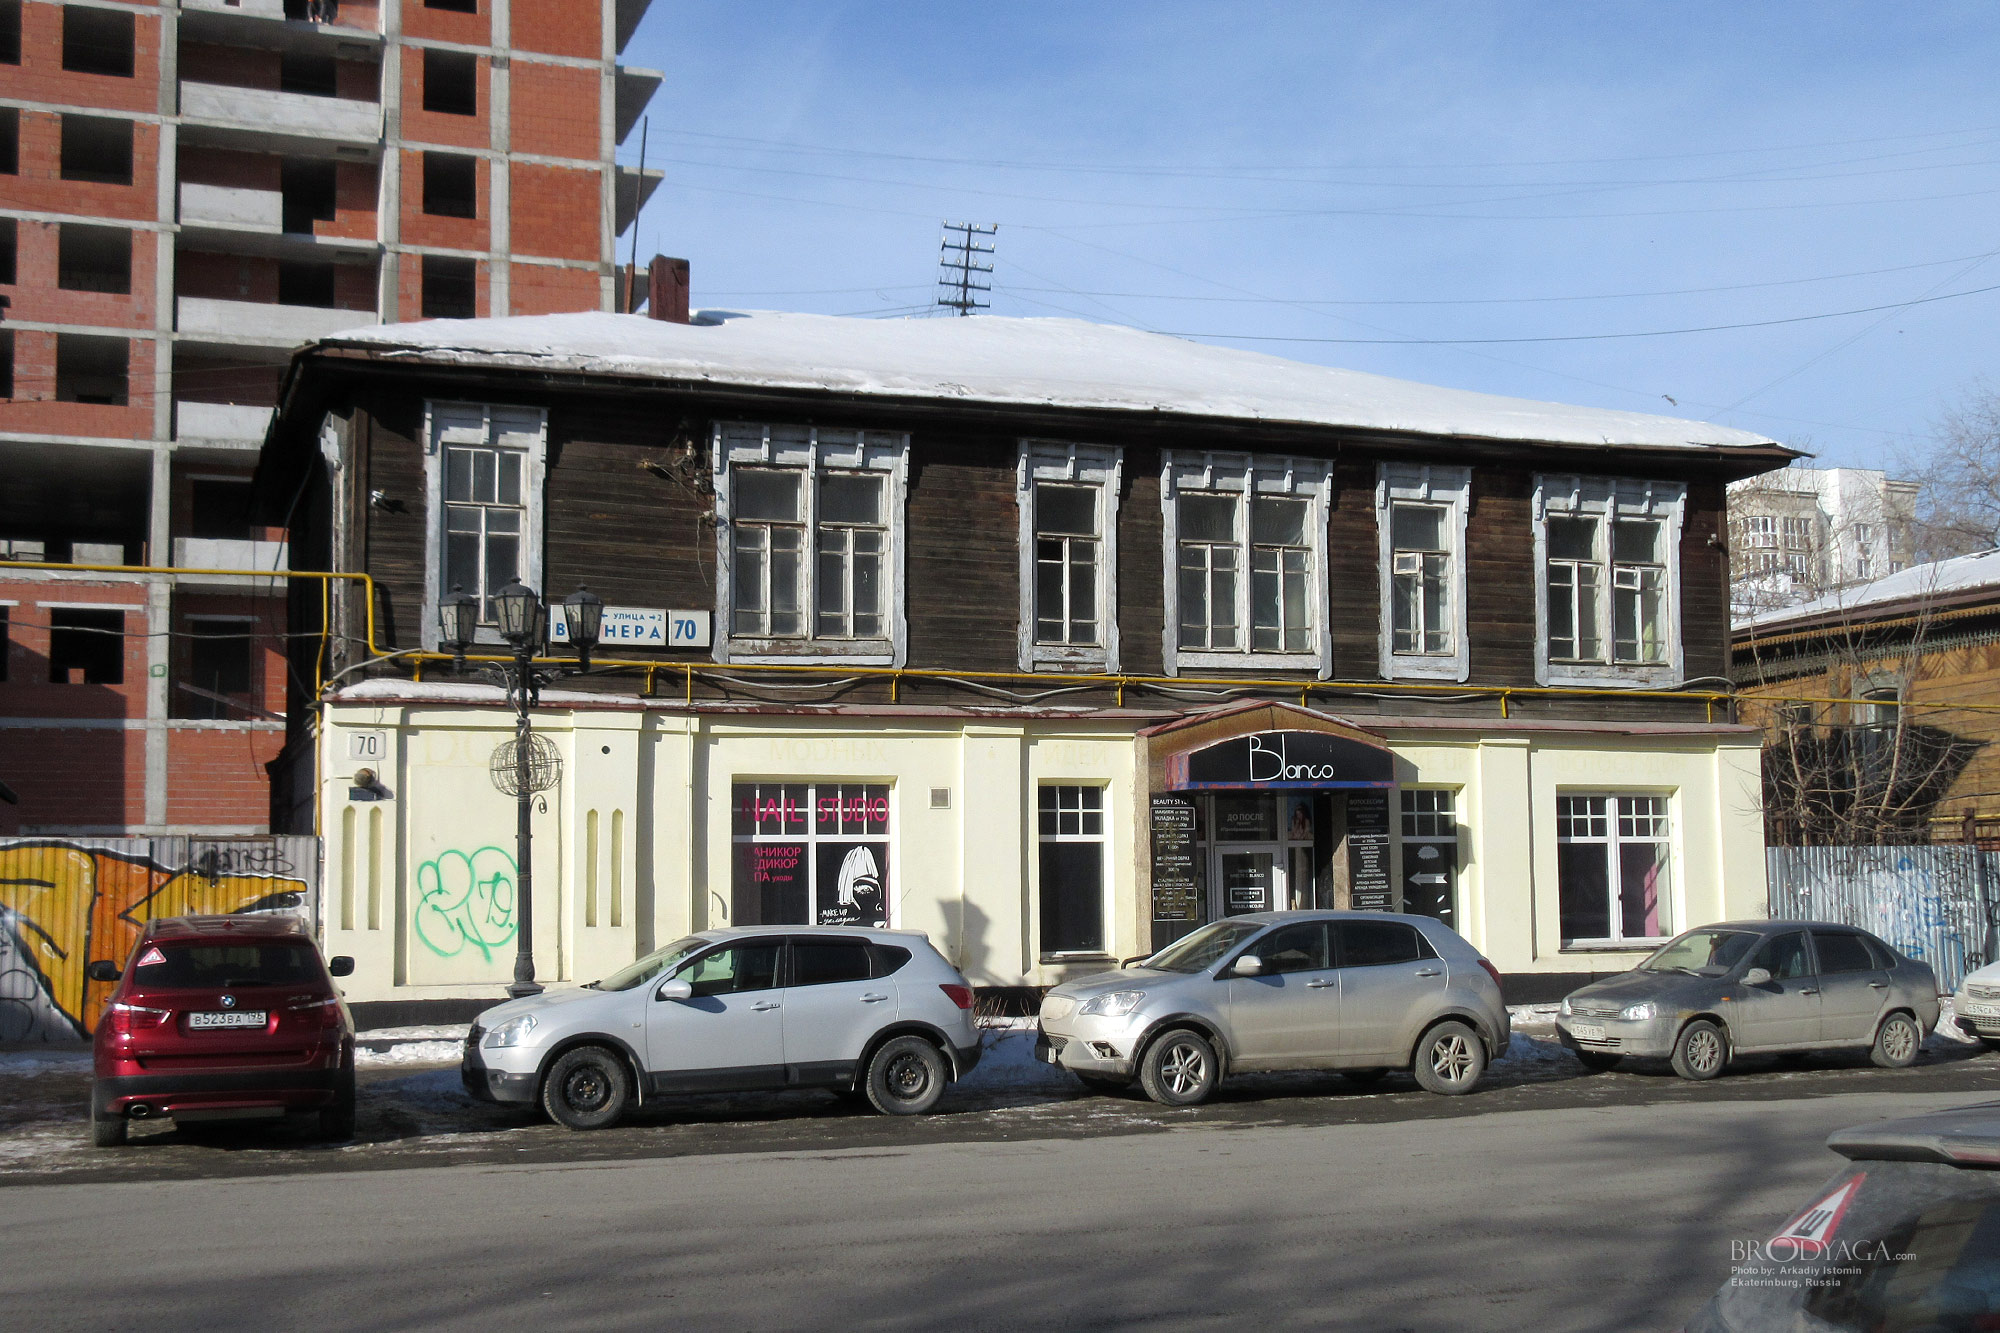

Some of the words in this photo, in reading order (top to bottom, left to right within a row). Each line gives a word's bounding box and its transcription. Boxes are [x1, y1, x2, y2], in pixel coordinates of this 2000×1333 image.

[613, 613, 645, 621] УЛИЦА
[556, 623, 661, 639] ВНЕРА
[674, 620, 697, 640] 70
[358, 736, 377, 755] 70
[1250, 734, 1334, 781] Blanco
[742, 798, 804, 822] NAIL
[818, 797, 889, 822] STUDIO
[1227, 813, 1238, 822] ДО
[1239, 813, 1264, 821] ПОСЛЕ
[745, 847, 802, 857] АНИКЮР
[745, 858, 799, 871] ДИКЮР
